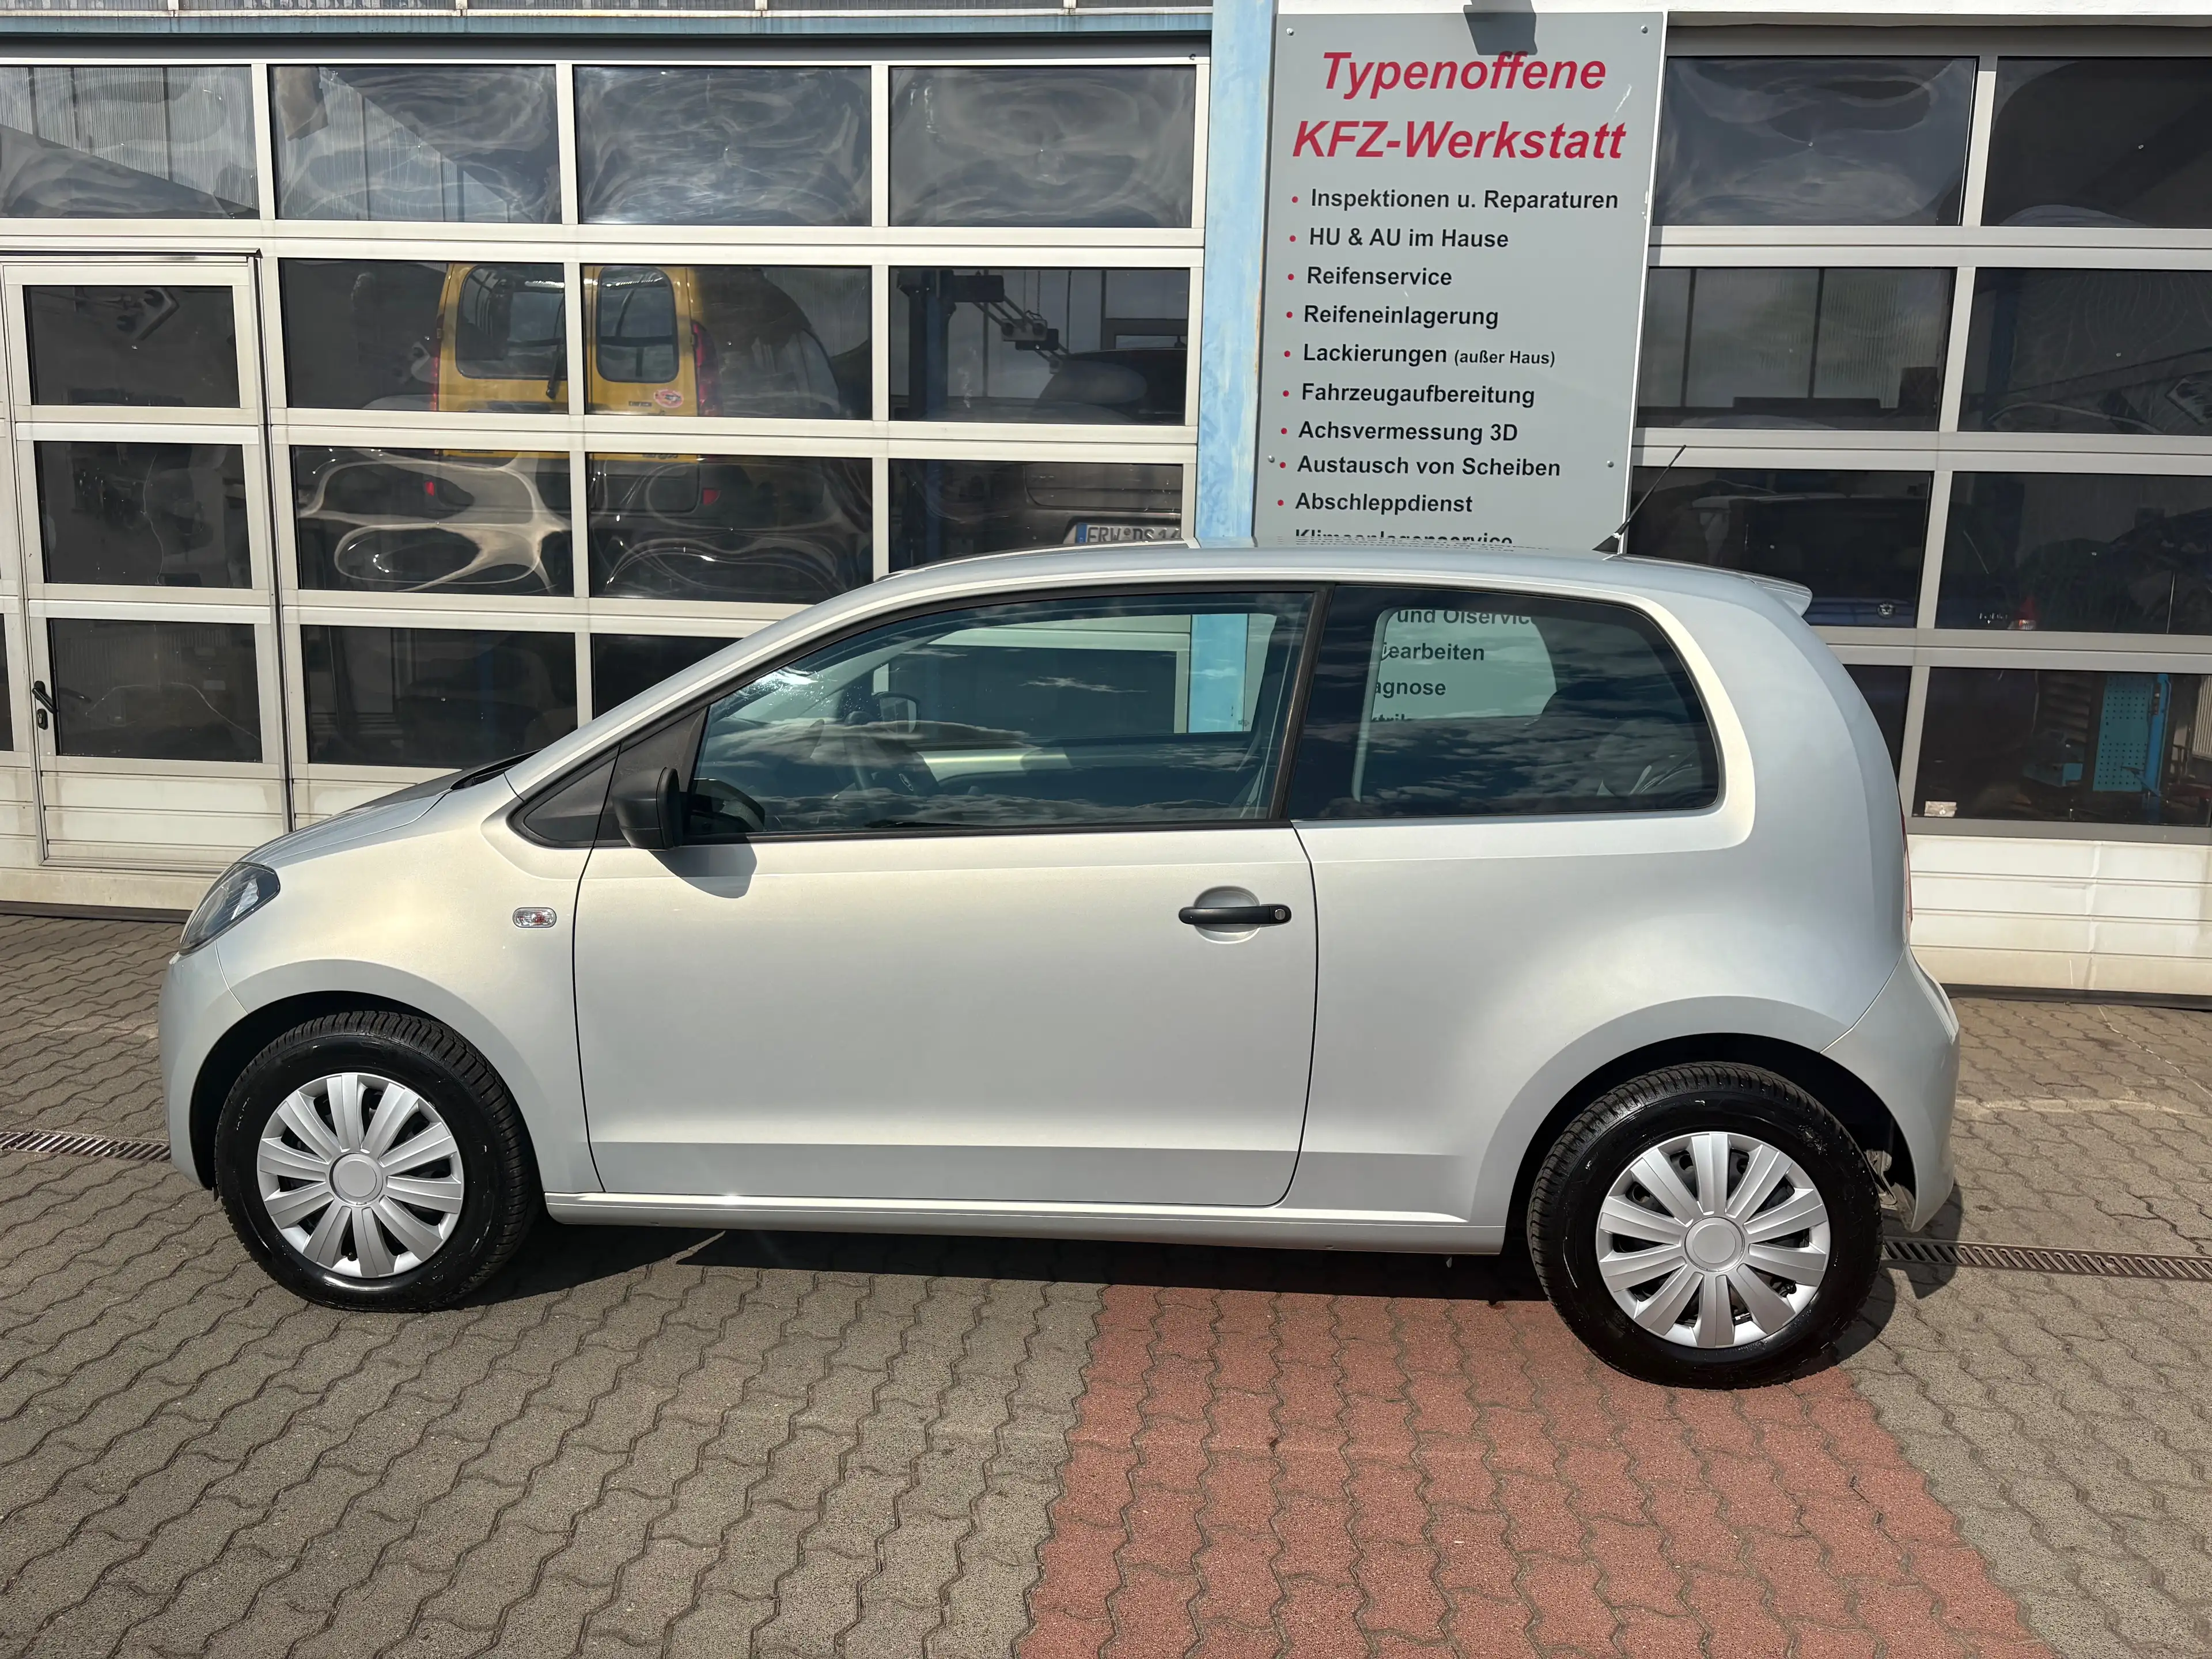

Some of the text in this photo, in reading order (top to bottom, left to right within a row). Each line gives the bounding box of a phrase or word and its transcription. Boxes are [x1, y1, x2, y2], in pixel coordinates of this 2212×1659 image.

[1324, 51, 1606, 100] Typenoffene
[1293, 120, 1627, 160] KFZ-Werkstatt
[1312, 188, 1618, 213] Inspektionen u. Reparaturen
[1310, 227, 1509, 248] HU & AU im Hause
[1307, 266, 1452, 286] Reifenservice
[1304, 305, 1498, 329] Reifeneinlagerung
[1304, 343, 1555, 368] Lackierungen (außer Haus)
[1302, 382, 1535, 408] Fahrzeugaufbereitung
[1298, 421, 1518, 445] Achsvermessung 3D
[1297, 455, 1560, 476] Austausch von Scheiben
[1295, 492, 1473, 516] Abschleppdienst
[1397, 609, 1436, 623] und
